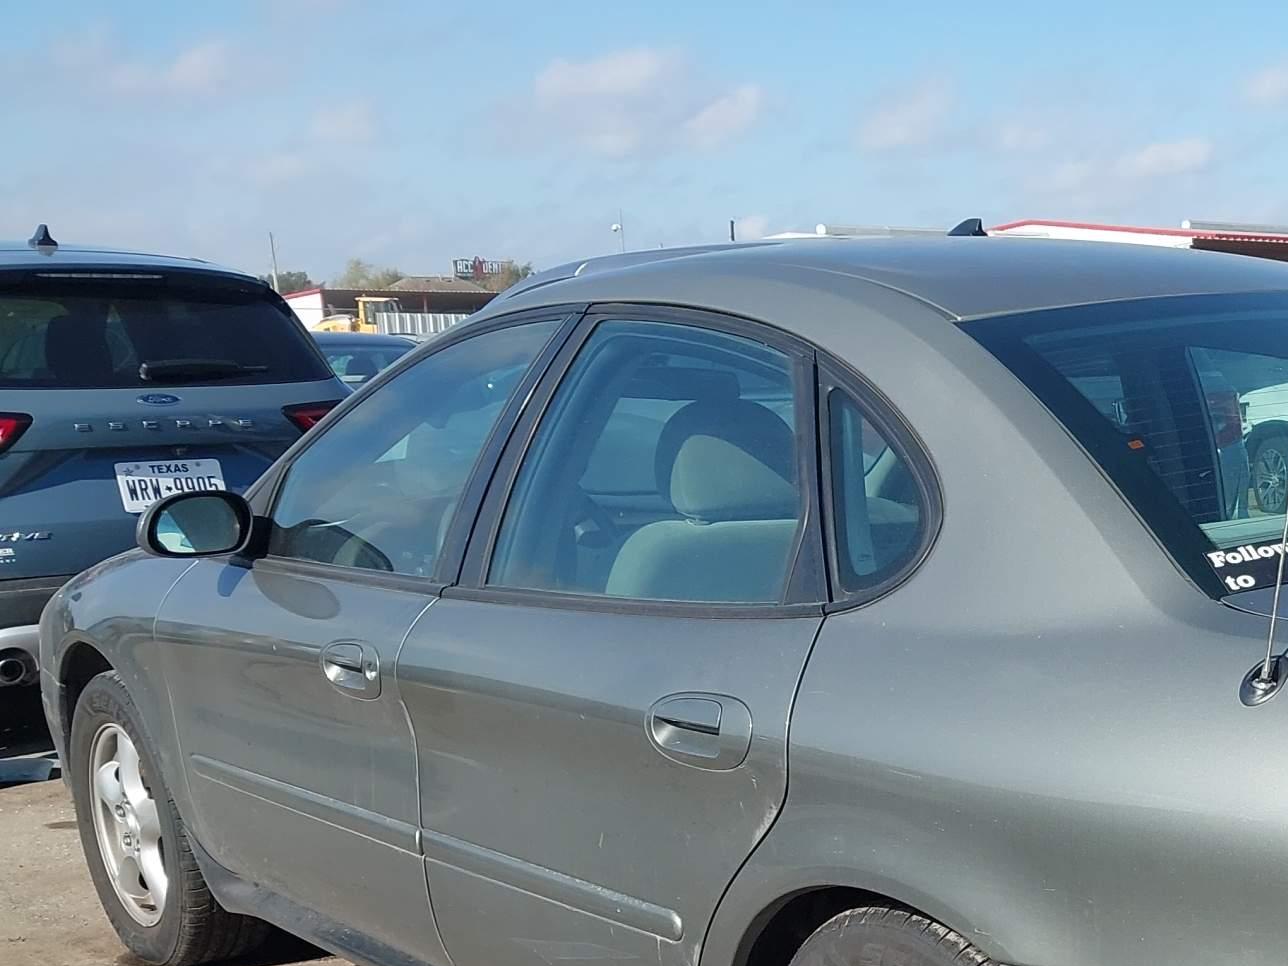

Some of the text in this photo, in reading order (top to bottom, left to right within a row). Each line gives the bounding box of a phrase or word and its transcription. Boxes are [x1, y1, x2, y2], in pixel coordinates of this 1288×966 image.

[148, 463, 189, 474] TEXAS
[126, 477, 162, 501] WRW
[1224, 573, 1256, 591] to
